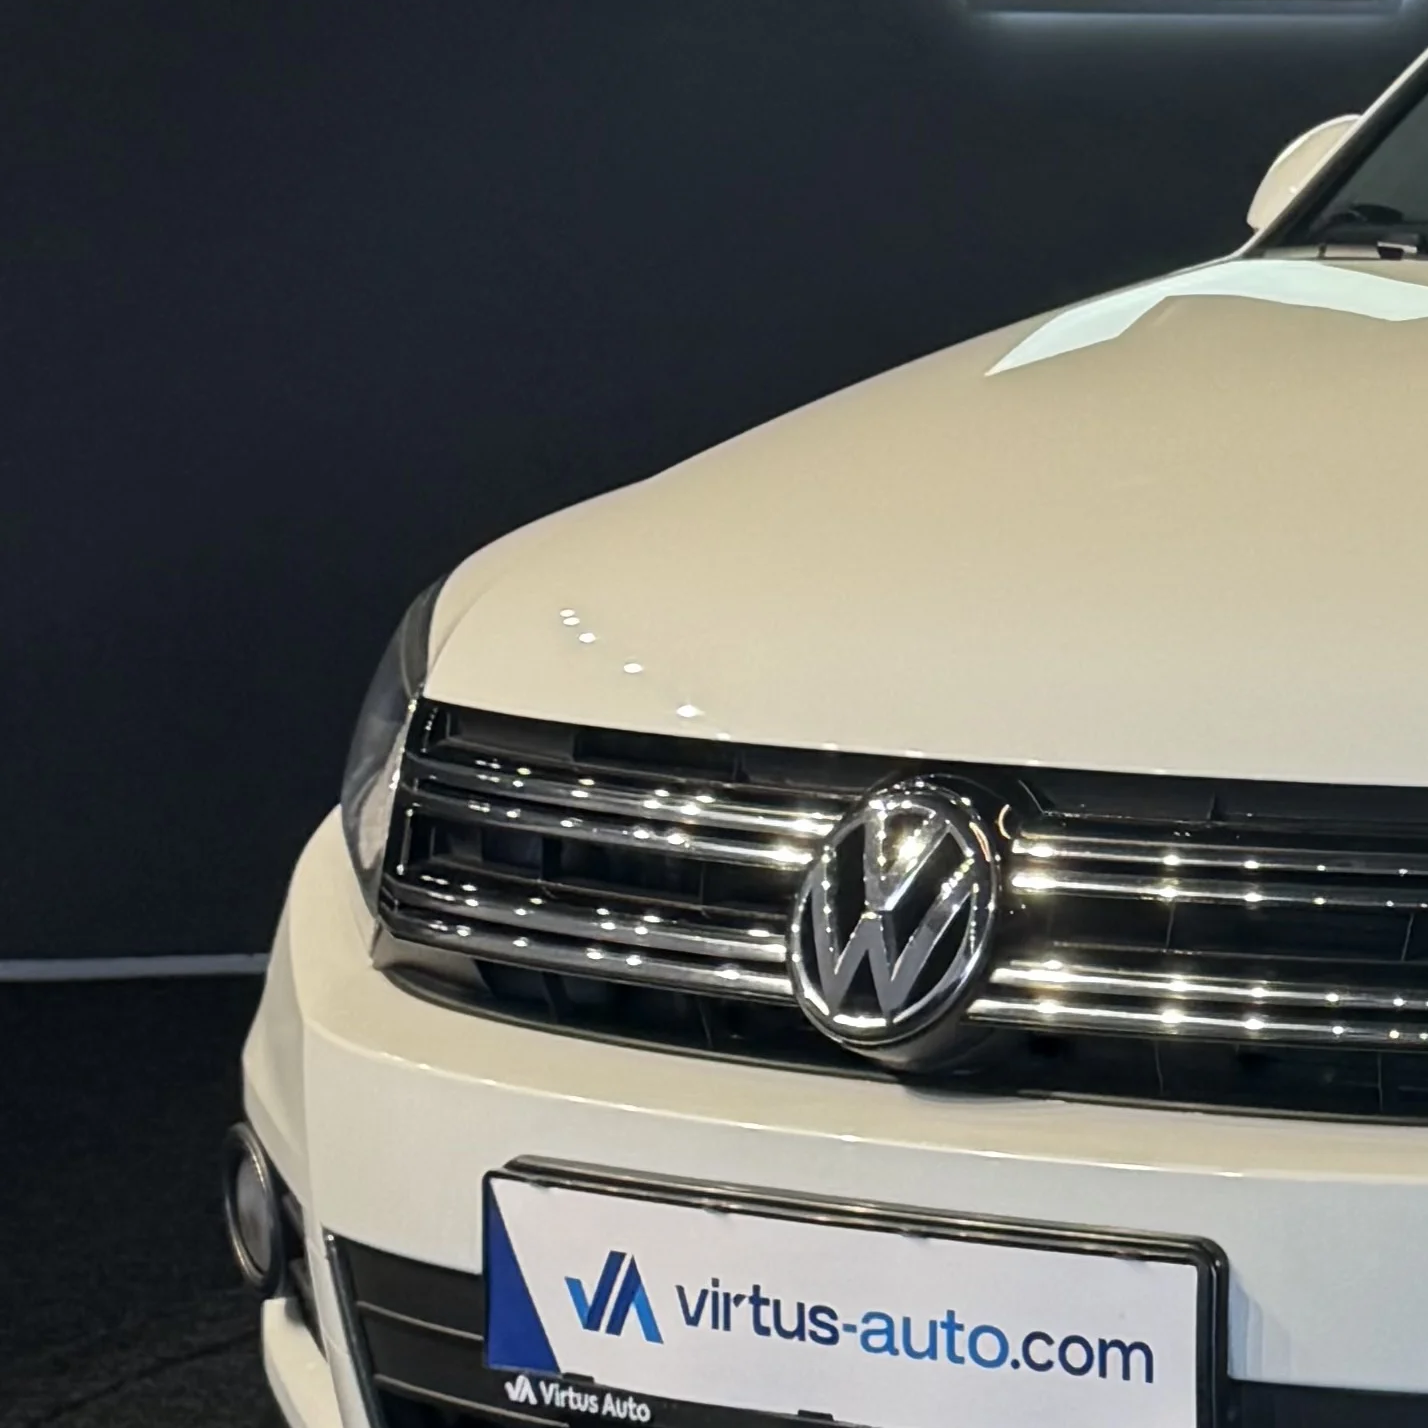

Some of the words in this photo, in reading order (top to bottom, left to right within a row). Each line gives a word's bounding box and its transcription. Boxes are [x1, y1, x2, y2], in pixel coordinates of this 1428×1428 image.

[674, 1277, 1155, 1384] virtus-auto.com
[539, 1380, 598, 1414] Virtus
[602, 1393, 651, 1422] Auto
